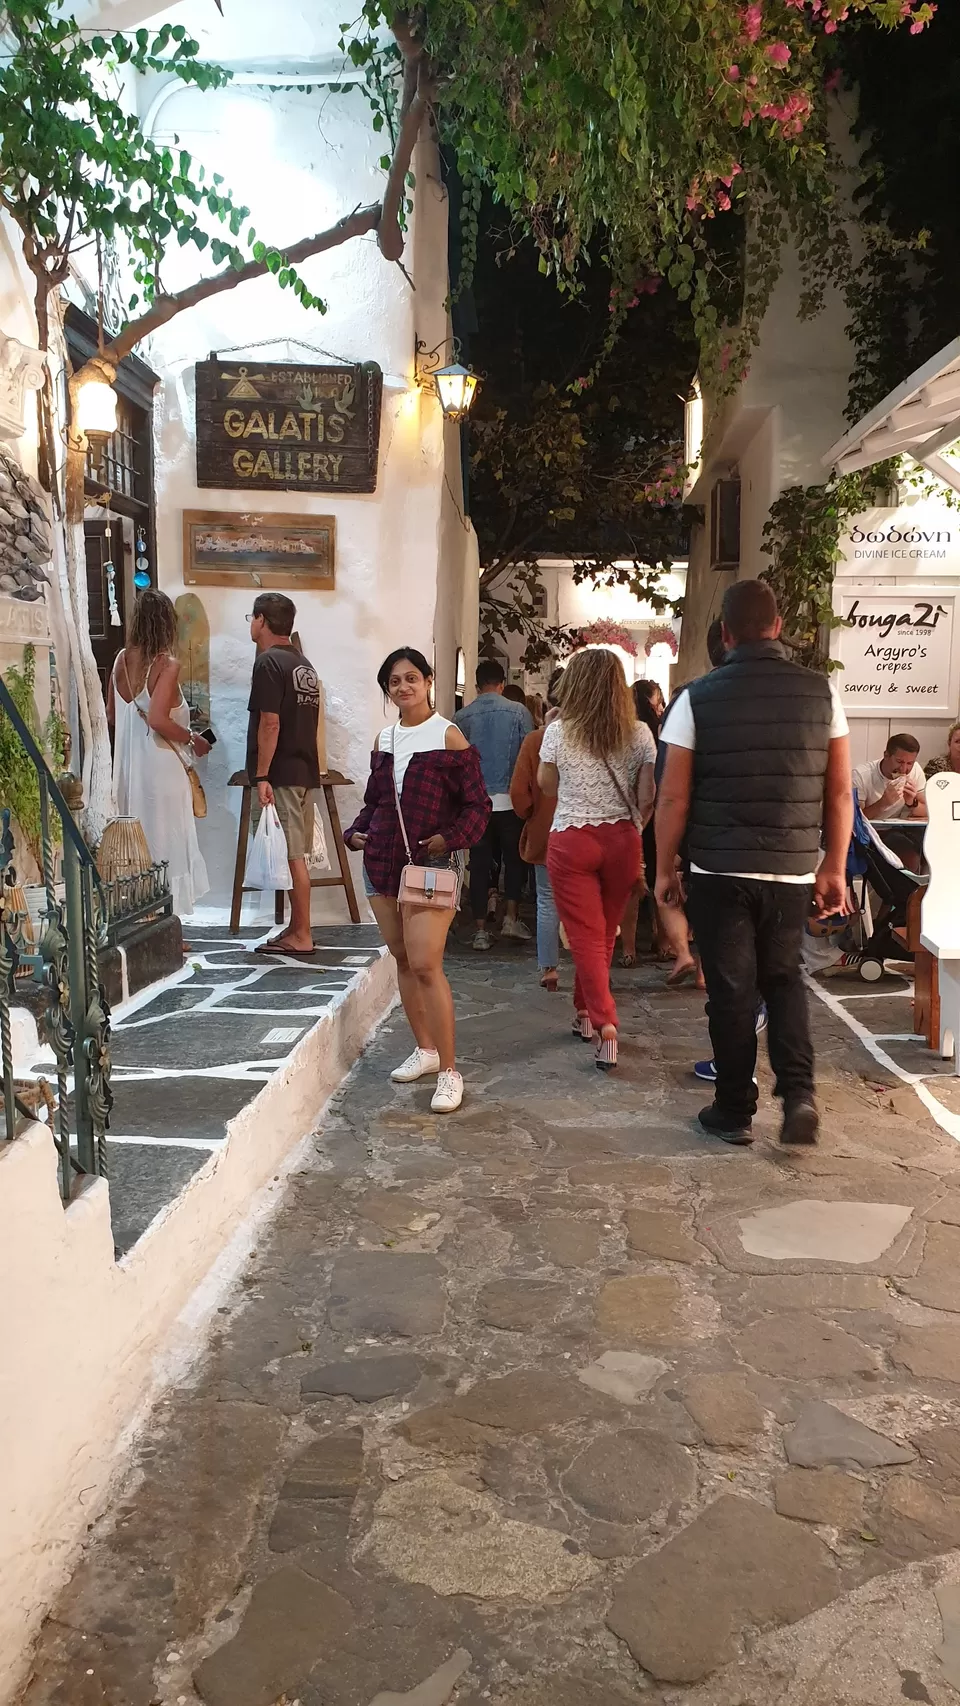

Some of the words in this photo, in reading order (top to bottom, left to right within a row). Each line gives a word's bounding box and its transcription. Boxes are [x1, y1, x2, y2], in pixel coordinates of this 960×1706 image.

[223, 408, 345, 443] GALATIS
[232, 449, 344, 482] GALLERY
[854, 550, 889, 559] DIVINE
[891, 550, 907, 559] ICE
[909, 550, 946, 559] CREAM
[864, 644, 928, 660] Argyro's
[876, 662, 913, 674] crepes
[844, 681, 882, 694] savory
[888, 682, 899, 693] &
[905, 682, 939, 693] sweet
